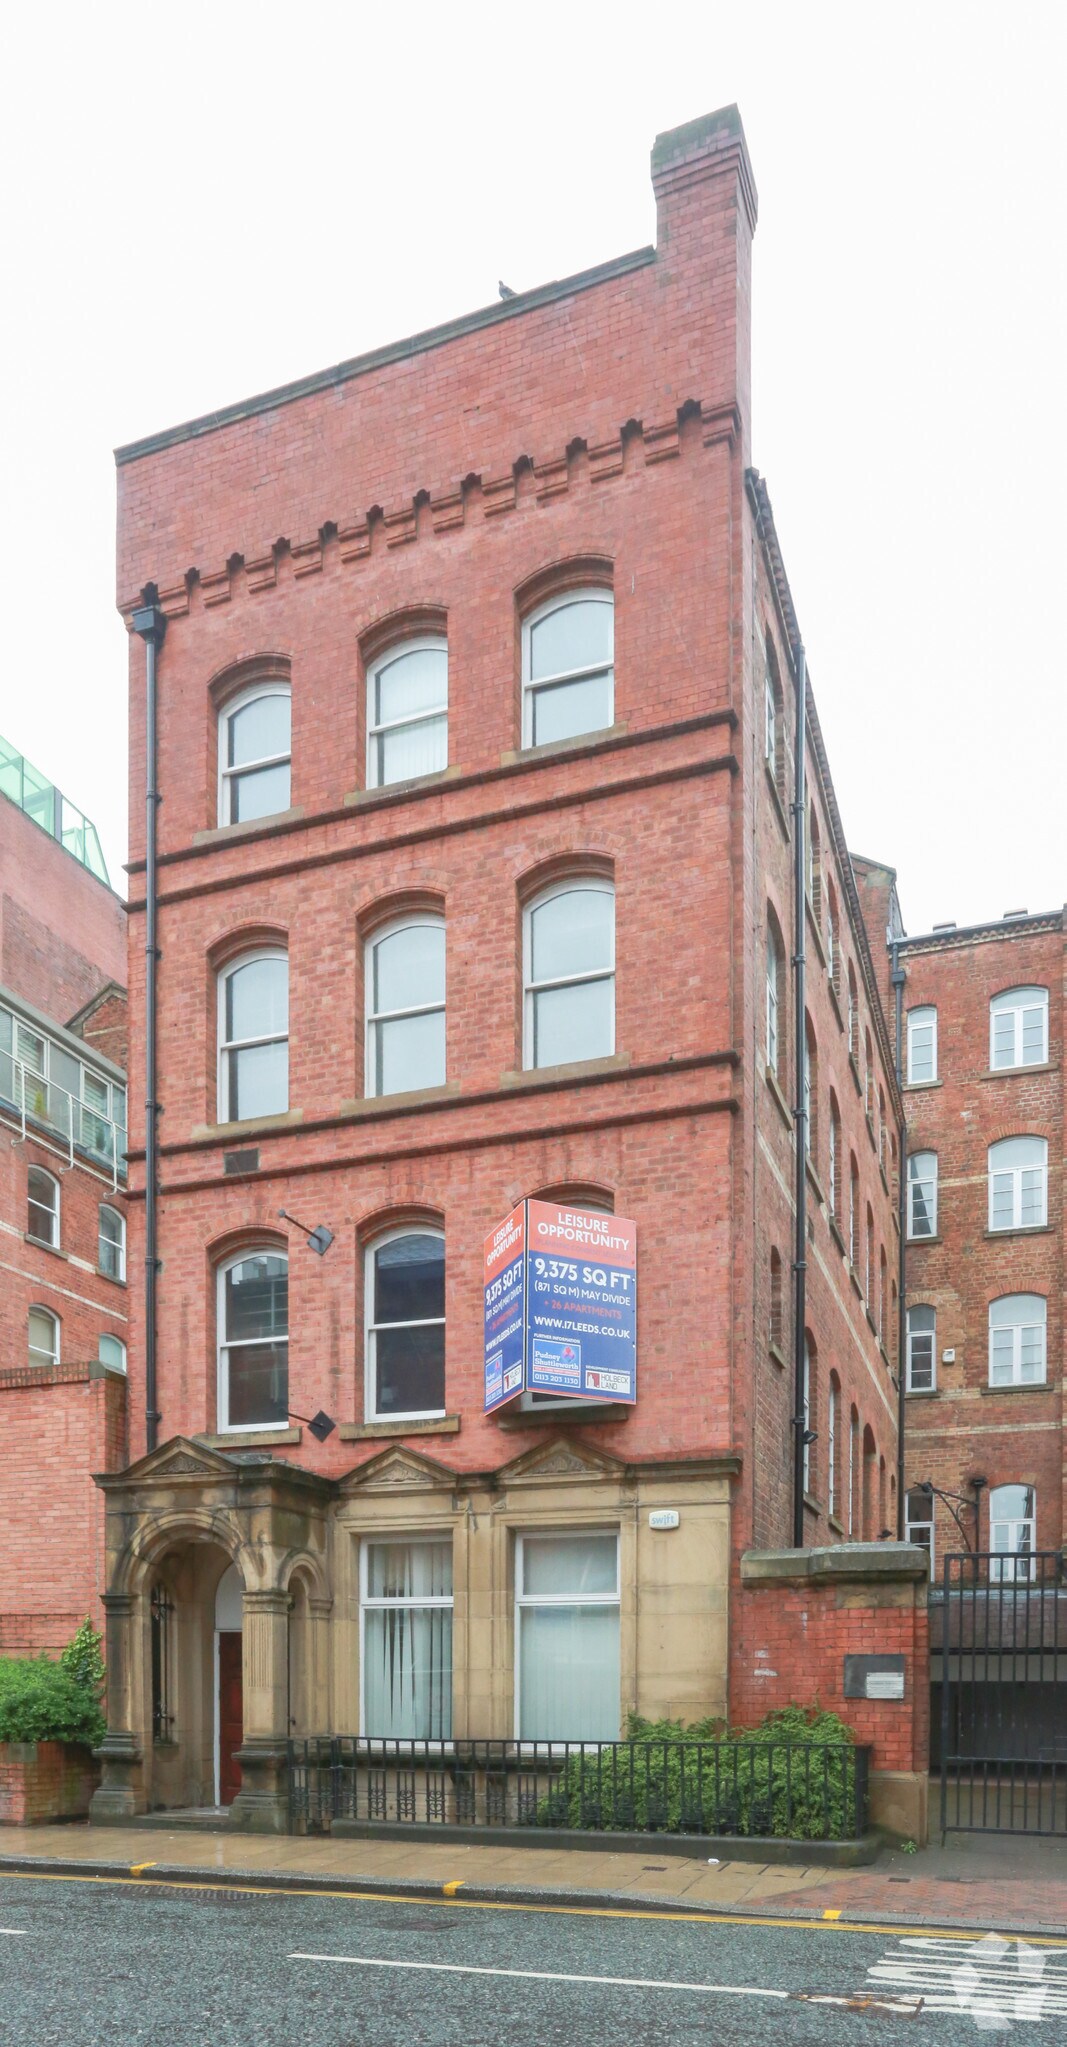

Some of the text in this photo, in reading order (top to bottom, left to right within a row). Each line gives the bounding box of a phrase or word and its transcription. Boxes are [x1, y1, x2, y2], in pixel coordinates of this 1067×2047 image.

[558, 1212, 609, 1233] LEISURE
[486, 1223, 523, 1266] OPPORTUNITY
[537, 1222, 630, 1251] OPPORTUNITY
[502, 1269, 513, 1291] SQ
[513, 1260, 523, 1282] FT
[534, 1258, 631, 1290] 9,375 SQ FT
[534, 1280, 631, 1306] (871 SQ M) MAY DIVIDE
[551, 1300, 562, 1309] 26
[563, 1302, 622, 1319] APARTMENTS
[534, 1315, 631, 1339] WWW.17LEEDS.CO.UK
[552, 1335, 581, 1344] INFORMATION
[534, 1350, 561, 1362] Pudney
[534, 1358, 579, 1370] Shuttleworth
[534, 1373, 579, 1385] 0113 203 1130
[601, 1374, 629, 1384] HOLBECK
[601, 1381, 618, 1390] LAND
[651, 1513, 675, 1525] swift
